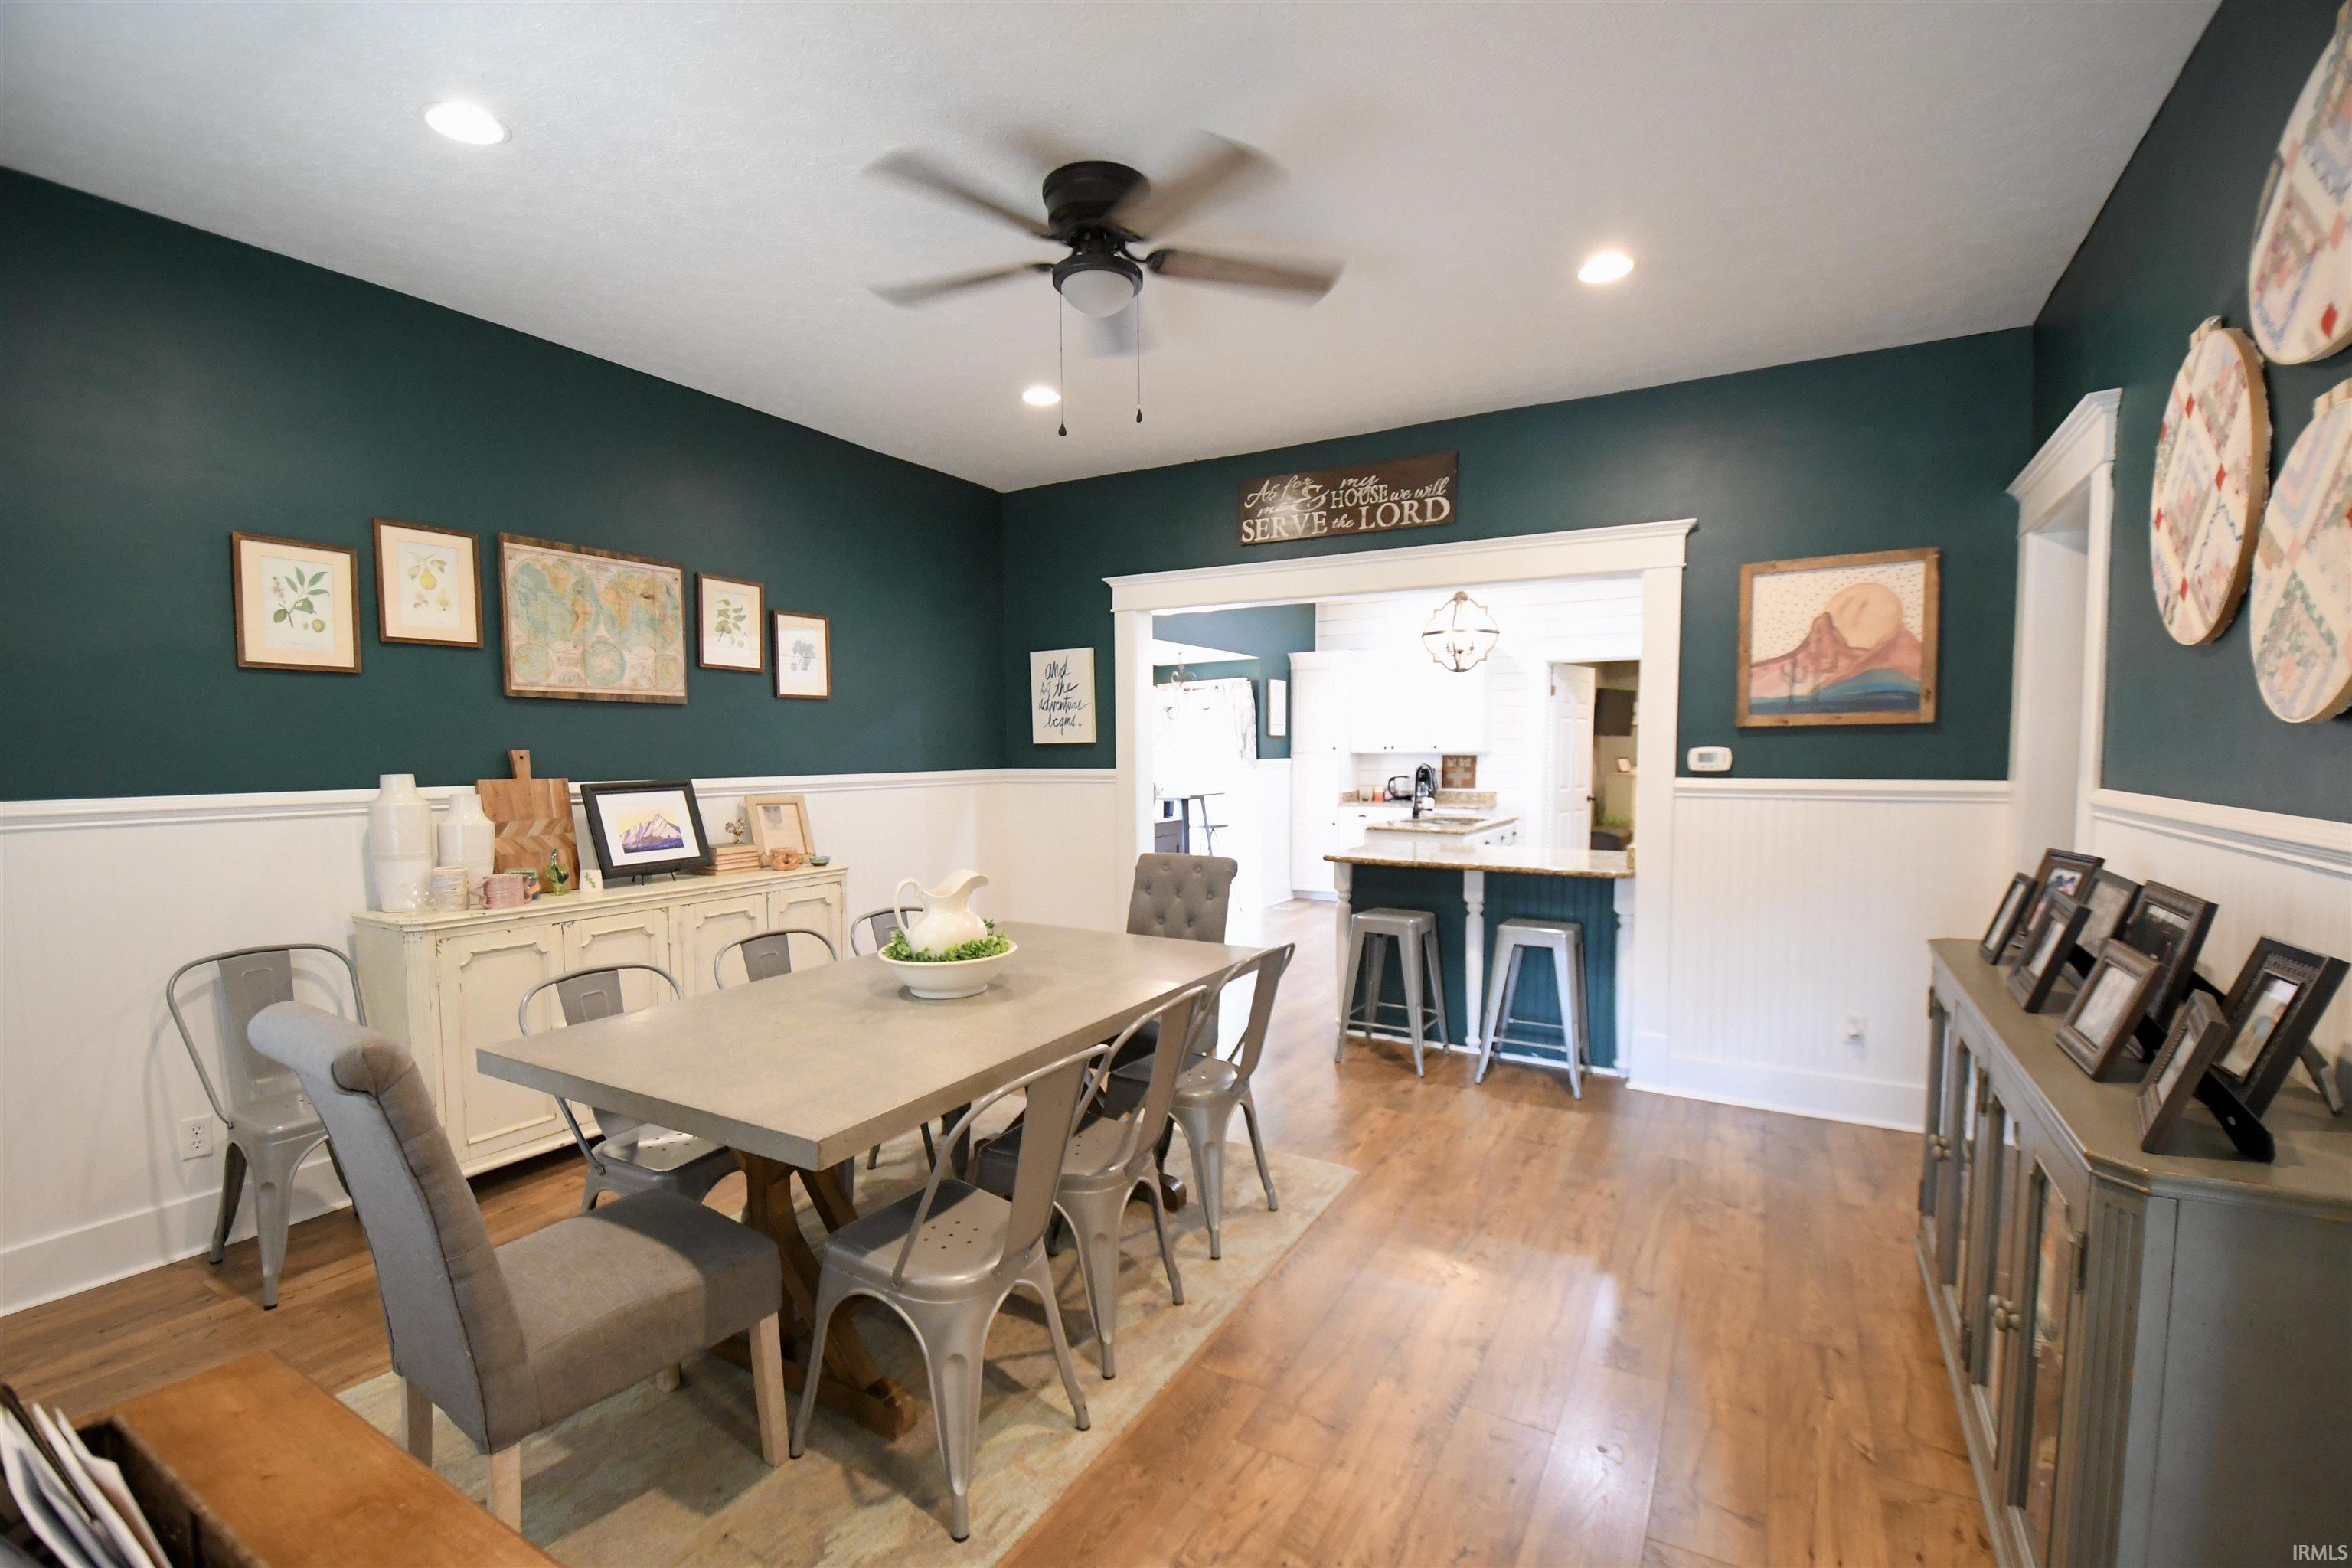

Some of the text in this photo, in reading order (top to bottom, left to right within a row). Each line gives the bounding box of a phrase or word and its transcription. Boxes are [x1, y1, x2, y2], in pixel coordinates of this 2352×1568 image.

[1244, 475, 1315, 508] As for
[1330, 476, 1450, 509] HOUSE we will
[1339, 475, 1379, 497] my
[1242, 496, 1451, 543] SERVE the LORD
[1045, 655, 1071, 680] and
[1053, 679, 1079, 697] the
[1039, 694, 1090, 713] adventure
